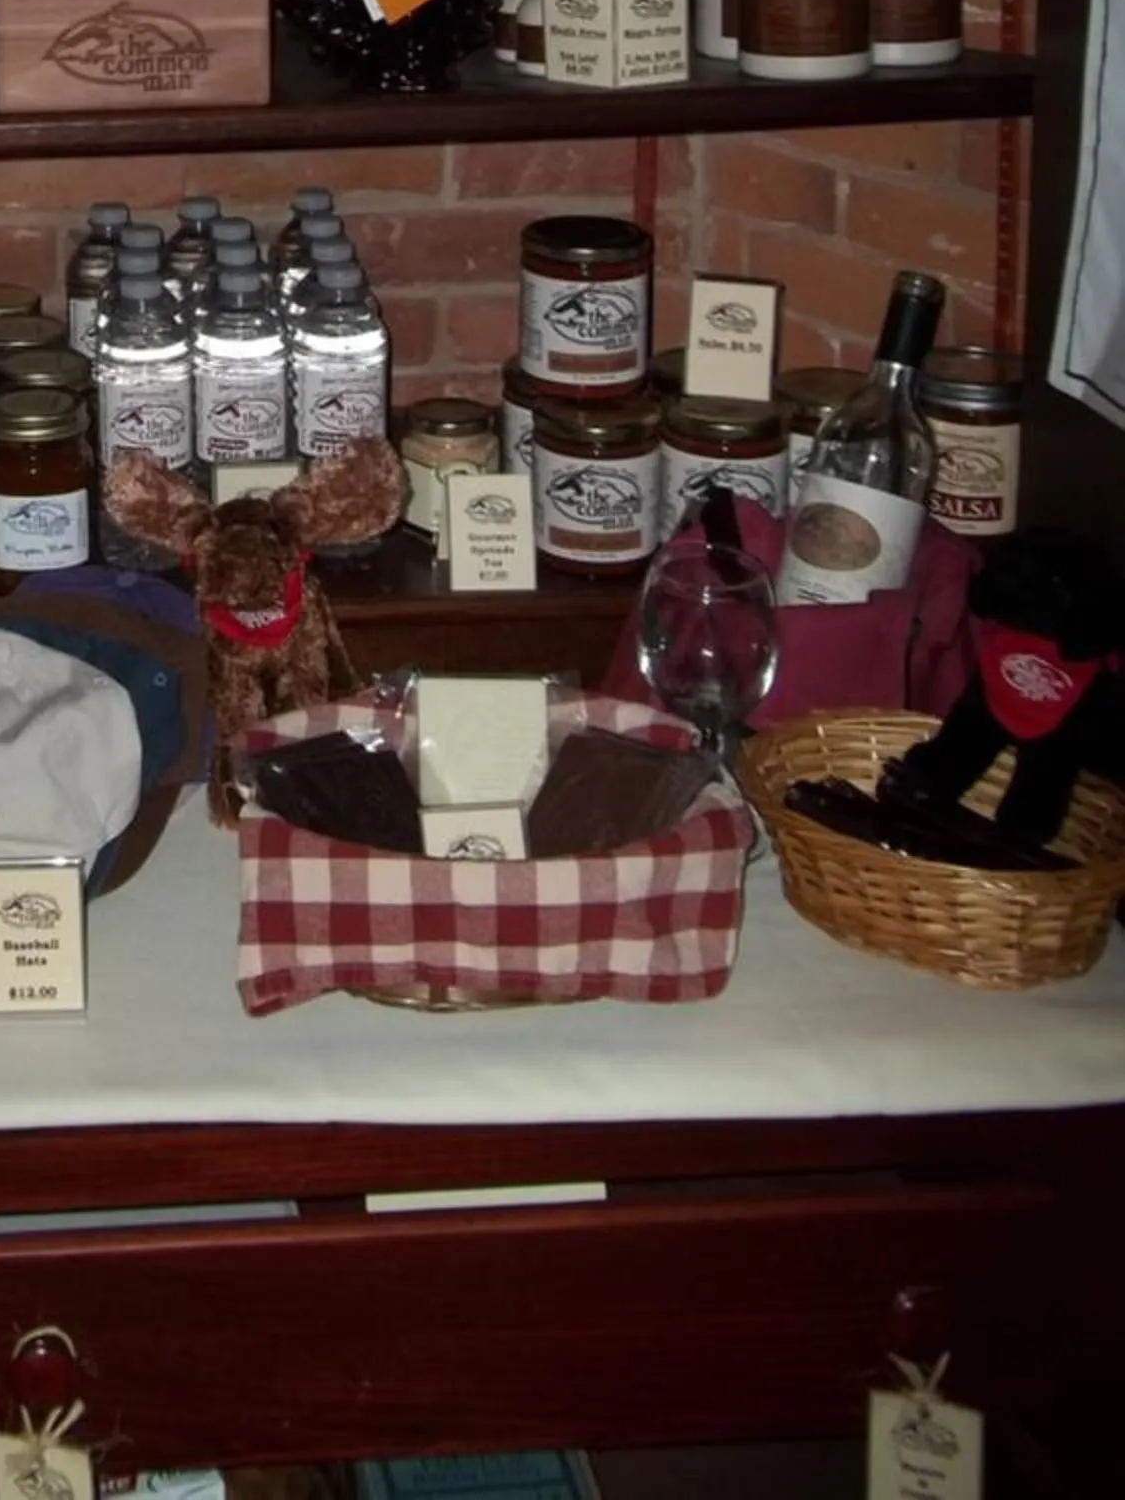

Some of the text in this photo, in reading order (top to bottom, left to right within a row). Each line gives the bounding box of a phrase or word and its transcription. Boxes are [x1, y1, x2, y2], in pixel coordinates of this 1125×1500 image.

[119, 33, 155, 56] the
[102, 52, 210, 77] common
[142, 71, 194, 92] man
[930, 493, 997, 518] SALSA
[3, 939, 60, 952] Baseball
[15, 955, 48, 967] Hats
